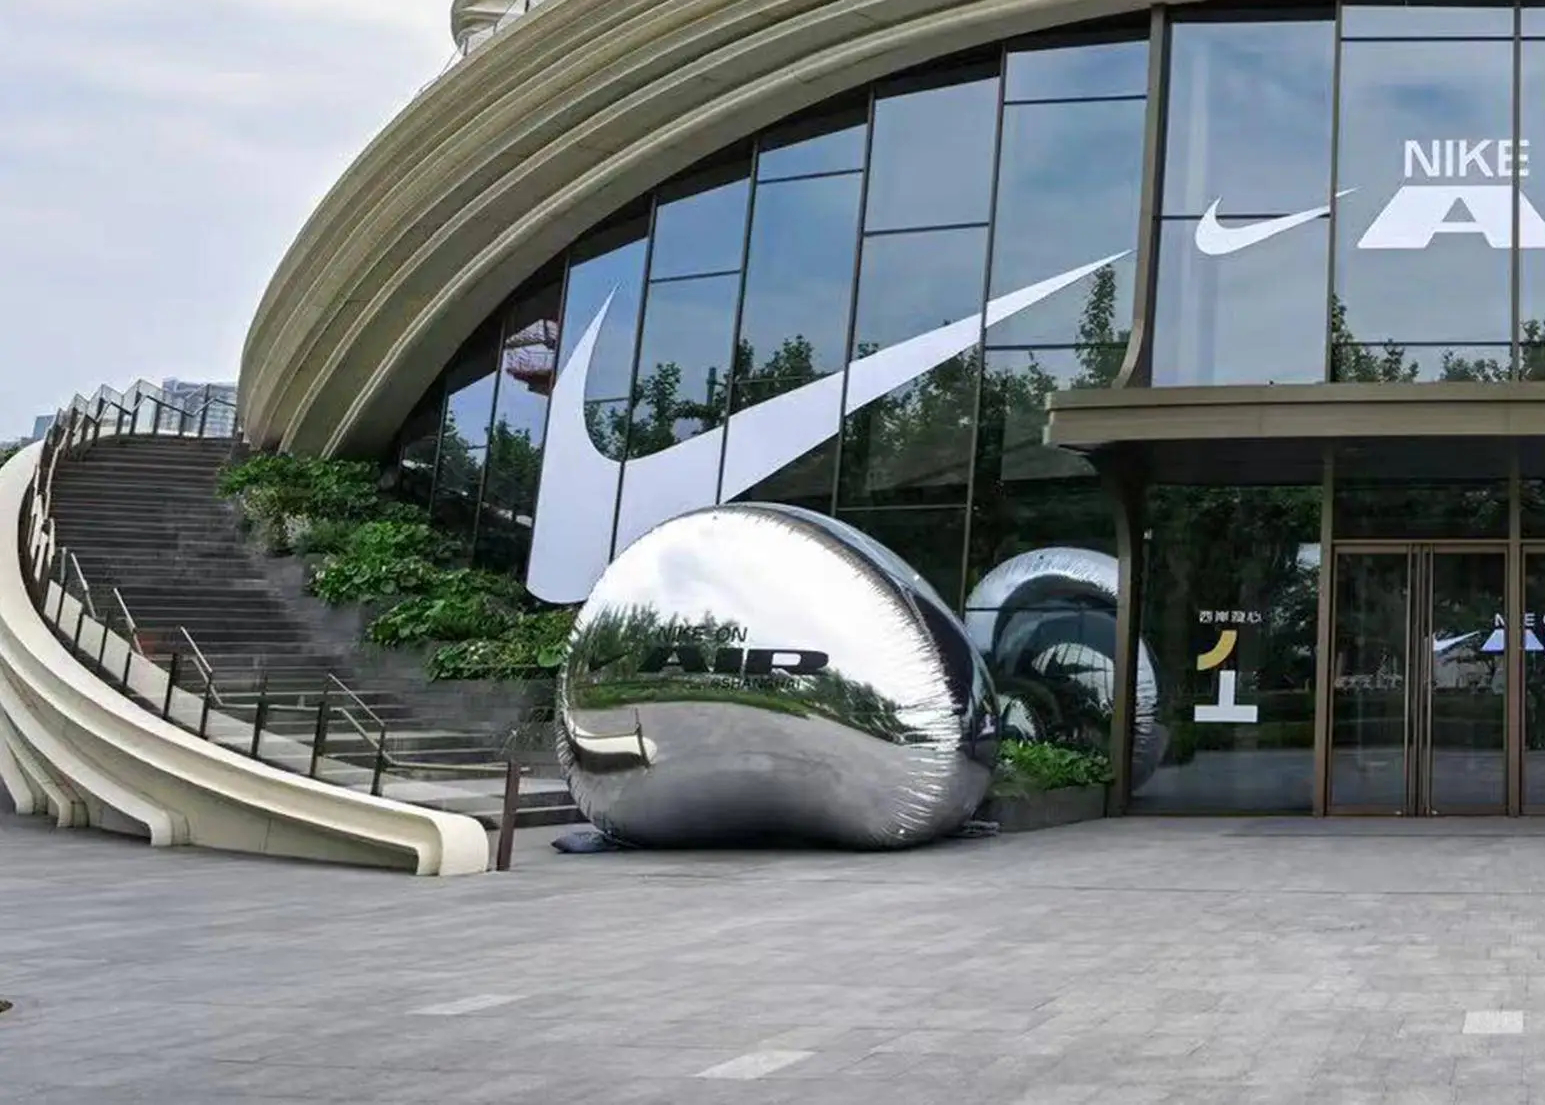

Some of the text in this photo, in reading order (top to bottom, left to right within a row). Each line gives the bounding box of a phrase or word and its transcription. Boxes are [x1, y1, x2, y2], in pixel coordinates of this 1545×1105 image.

[1404, 139, 1529, 177] NIKE
[1494, 612, 1536, 627] NE
[658, 625, 748, 643] NIKE ON
[636, 646, 830, 675] AIR
